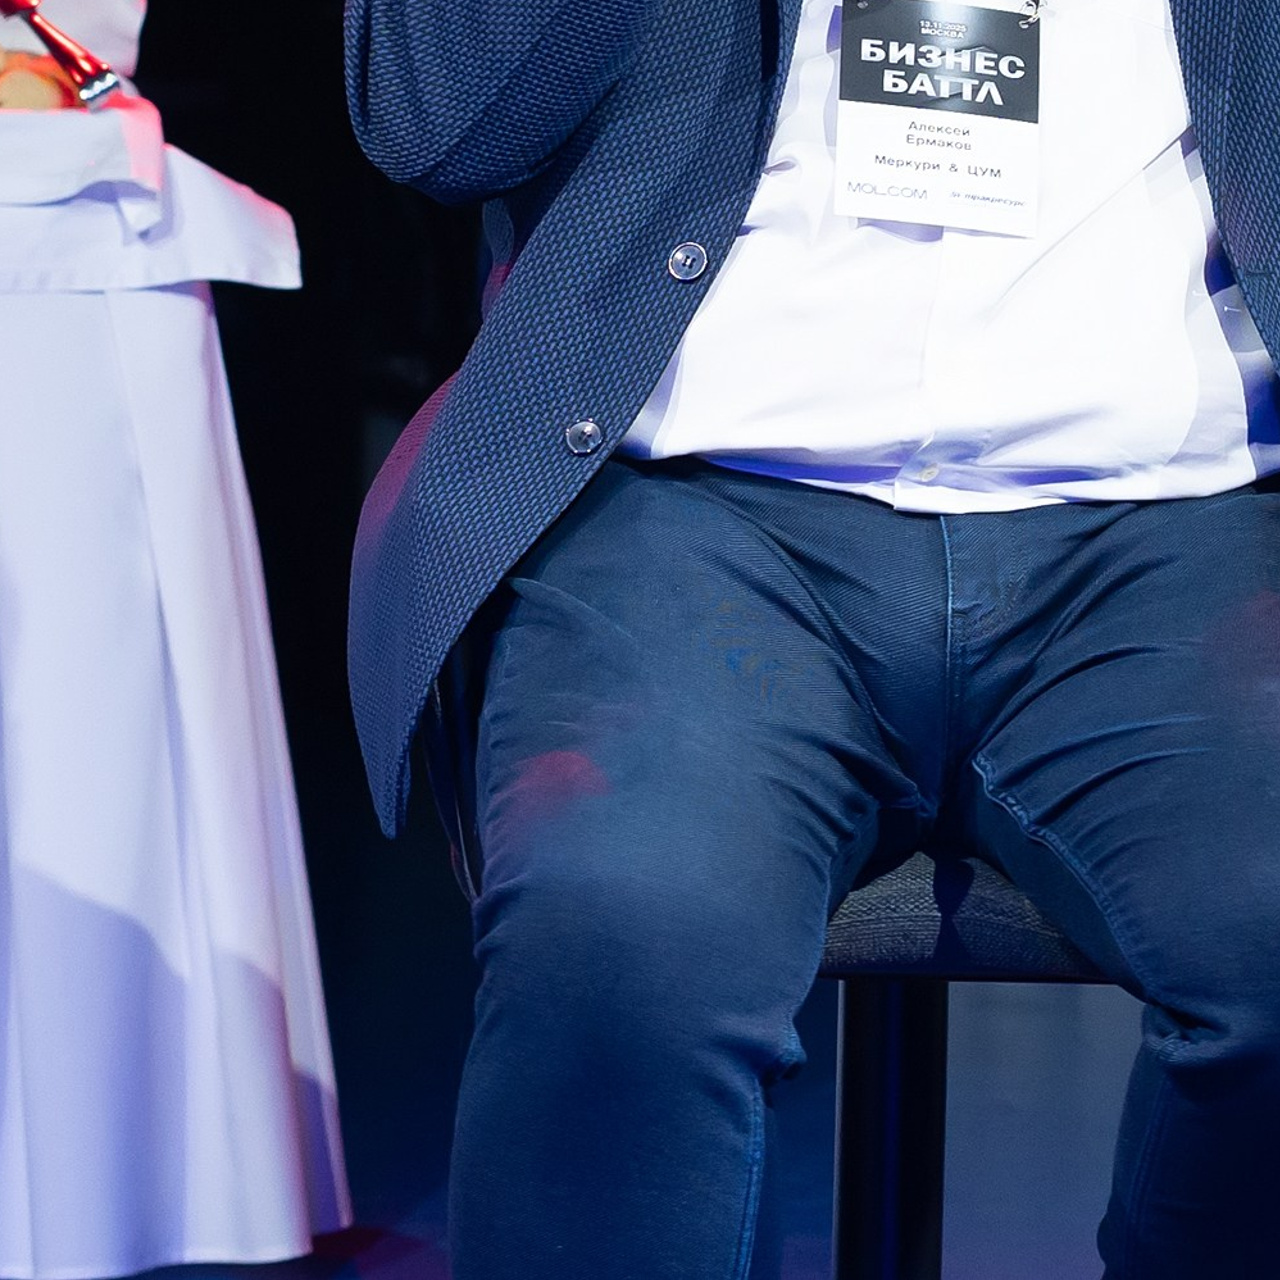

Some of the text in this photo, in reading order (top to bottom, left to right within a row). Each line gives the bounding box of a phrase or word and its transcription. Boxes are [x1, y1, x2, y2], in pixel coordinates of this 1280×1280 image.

[860, 38, 1026, 79] БИЗНЕС
[882, 69, 1005, 106] БАТТЛ
[908, 120, 971, 137] Алексей
[905, 133, 972, 151] Ермаков
[874, 154, 1002, 179] Меркури & ЦУМ
[847, 180, 928, 200] MOLCOM
